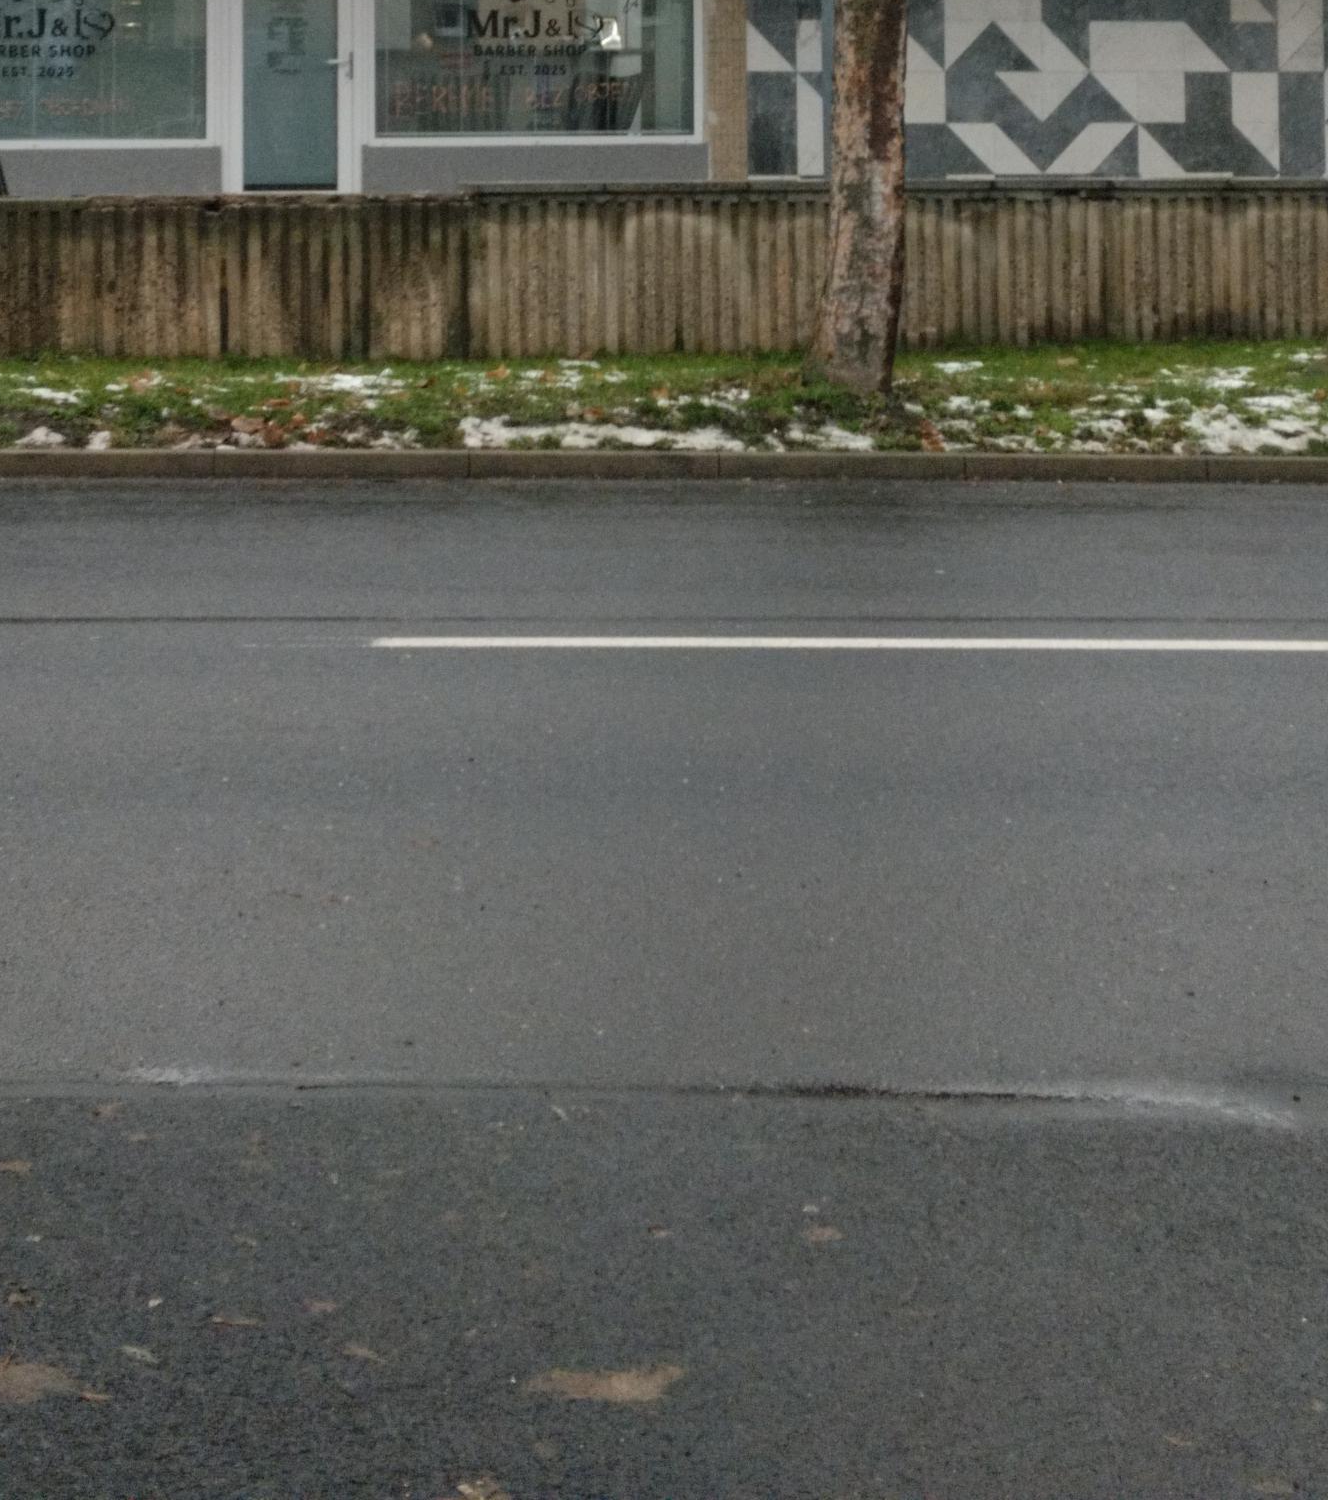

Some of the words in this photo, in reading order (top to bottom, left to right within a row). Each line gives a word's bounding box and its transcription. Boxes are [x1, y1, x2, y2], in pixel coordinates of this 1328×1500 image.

[51, 18, 68, 37] &
[545, 18, 561, 37] &
[48, 44, 96, 58] SHOP
[474, 43, 537, 57] BARBER
[544, 43, 587, 56] SHOP
[39, 66, 75, 78] 2025
[534, 64, 567, 76] 2025
